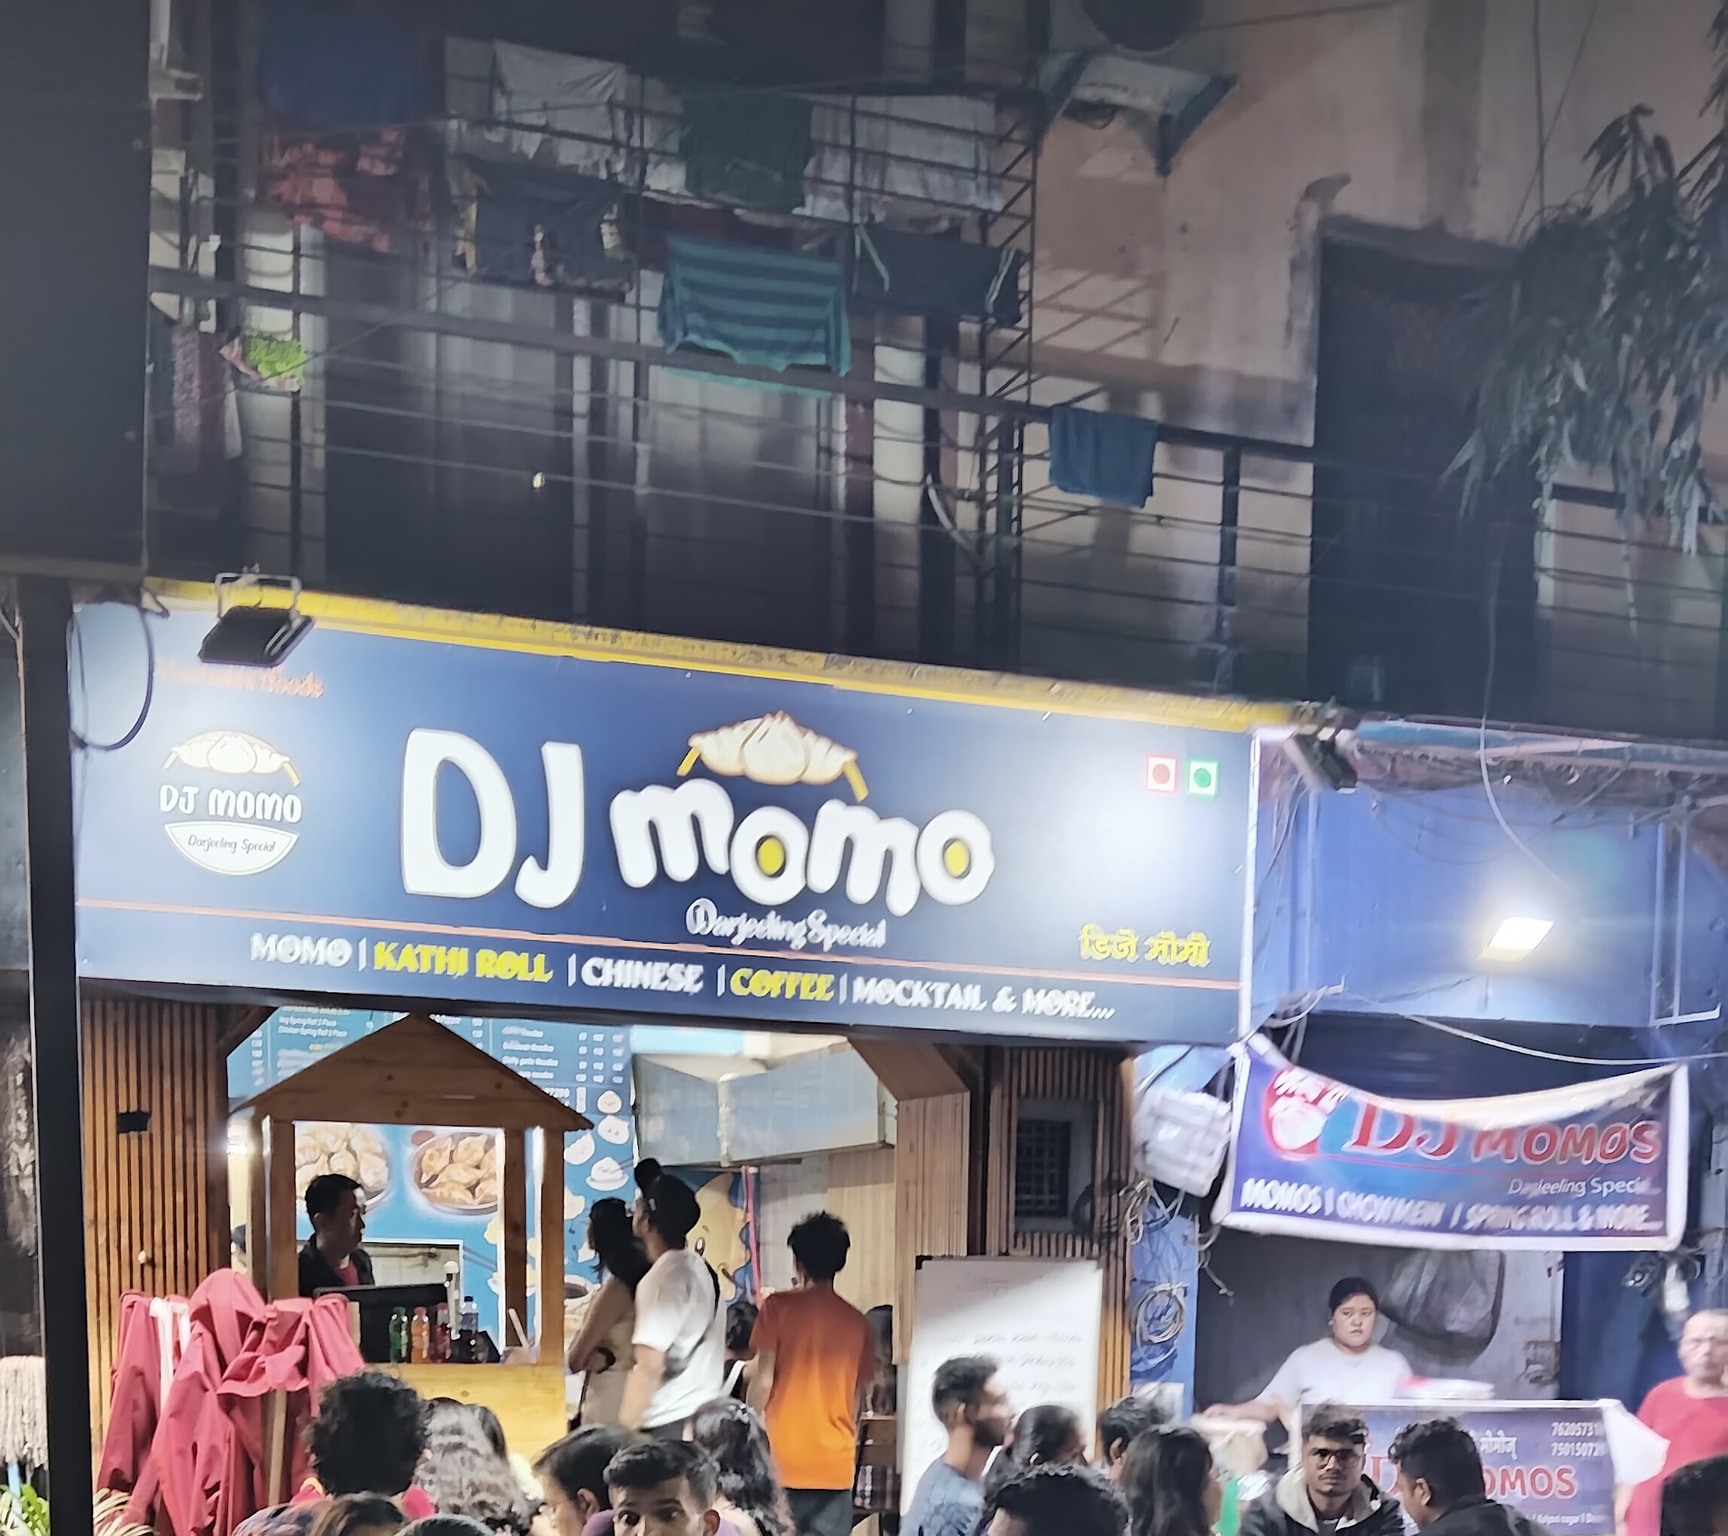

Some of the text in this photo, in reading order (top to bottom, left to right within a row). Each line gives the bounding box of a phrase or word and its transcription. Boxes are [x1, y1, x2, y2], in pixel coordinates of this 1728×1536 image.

[159, 784, 200, 815] DJ
[402, 727, 585, 908] DJ
[187, 834, 277, 855] Darjeeling Special
[686, 897, 887, 952] Darjeeling Special
[250, 932, 353, 968] MOMO
[373, 941, 470, 979] KATHI
[475, 949, 554, 983] ROLL
[581, 956, 704, 996] CHINESE
[730, 967, 835, 1001] COFFEE
[852, 976, 988, 1012] MOCKTAIL
[991, 985, 1019, 1013] &
[1340, 1100, 1663, 1166] DJ MOMOS
[1239, 1177, 1323, 1215] MOMOS
